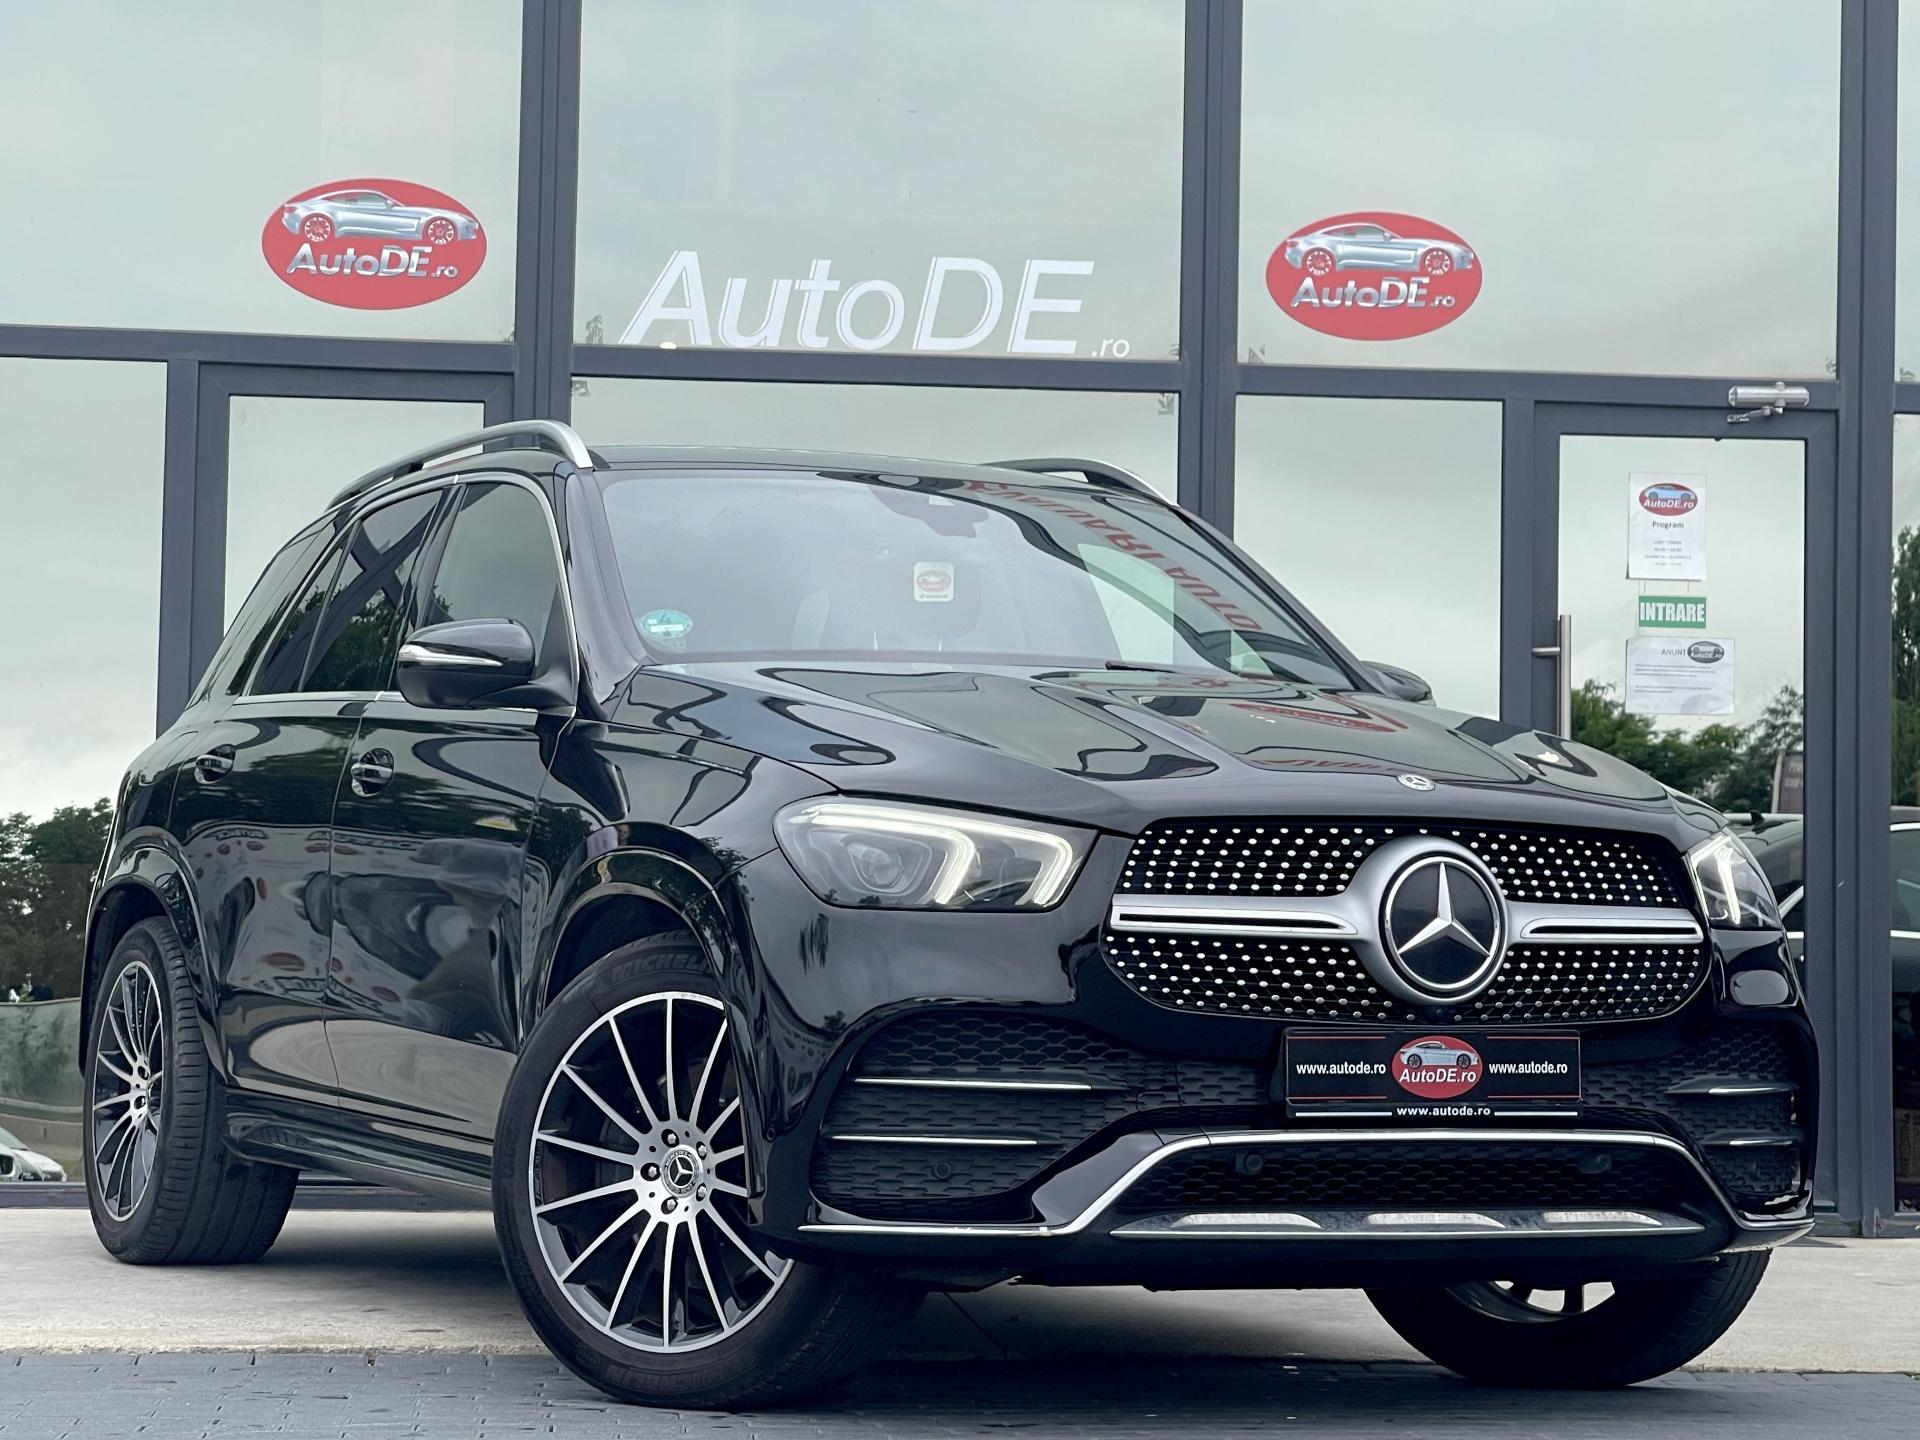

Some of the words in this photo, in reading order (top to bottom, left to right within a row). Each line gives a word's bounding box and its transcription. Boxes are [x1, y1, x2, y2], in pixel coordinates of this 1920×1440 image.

[1652, 520, 1685, 530] Program
[1640, 602, 1705, 622] INTRARE
[1296, 1060, 1386, 1075] www.autode.ro
[1488, 1060, 1568, 1074] www.autode.ro
[1398, 1067, 1477, 1084] AutoDE.ro
[1396, 1105, 1491, 1117] www.autode.ro
